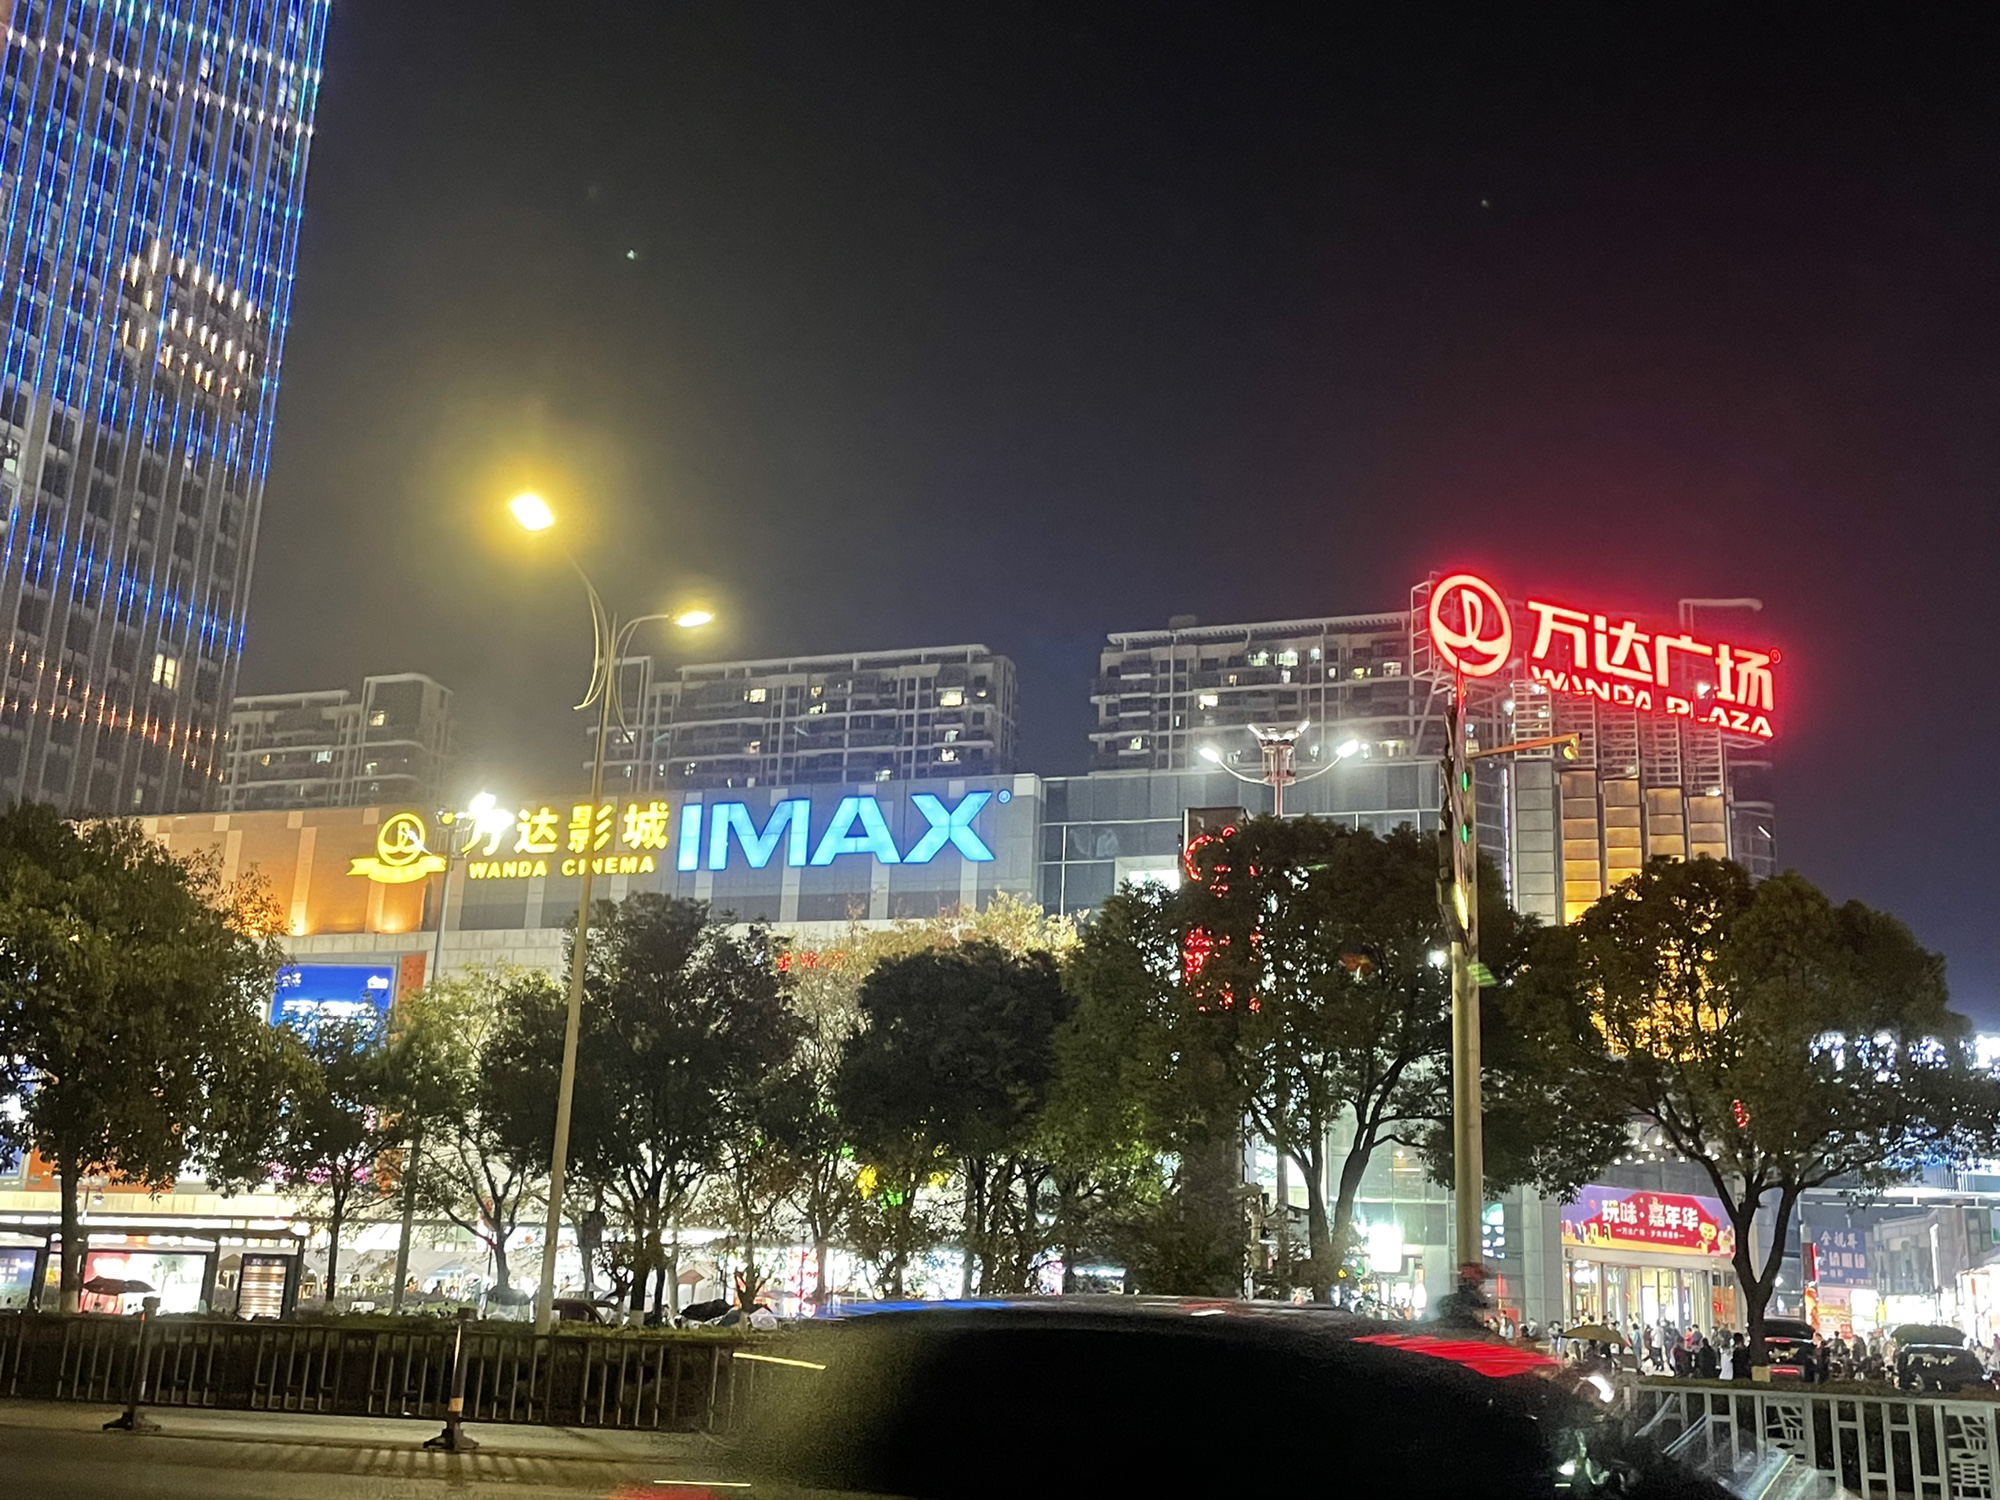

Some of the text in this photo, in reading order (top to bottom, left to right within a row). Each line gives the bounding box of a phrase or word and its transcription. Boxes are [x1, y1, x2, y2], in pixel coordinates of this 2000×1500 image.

[1527, 600, 1774, 711] 万达广场
[1530, 665, 1653, 711] WANDA
[677, 791, 996, 872] IMAX
[469, 855, 655, 880] WANDA CINEMA
